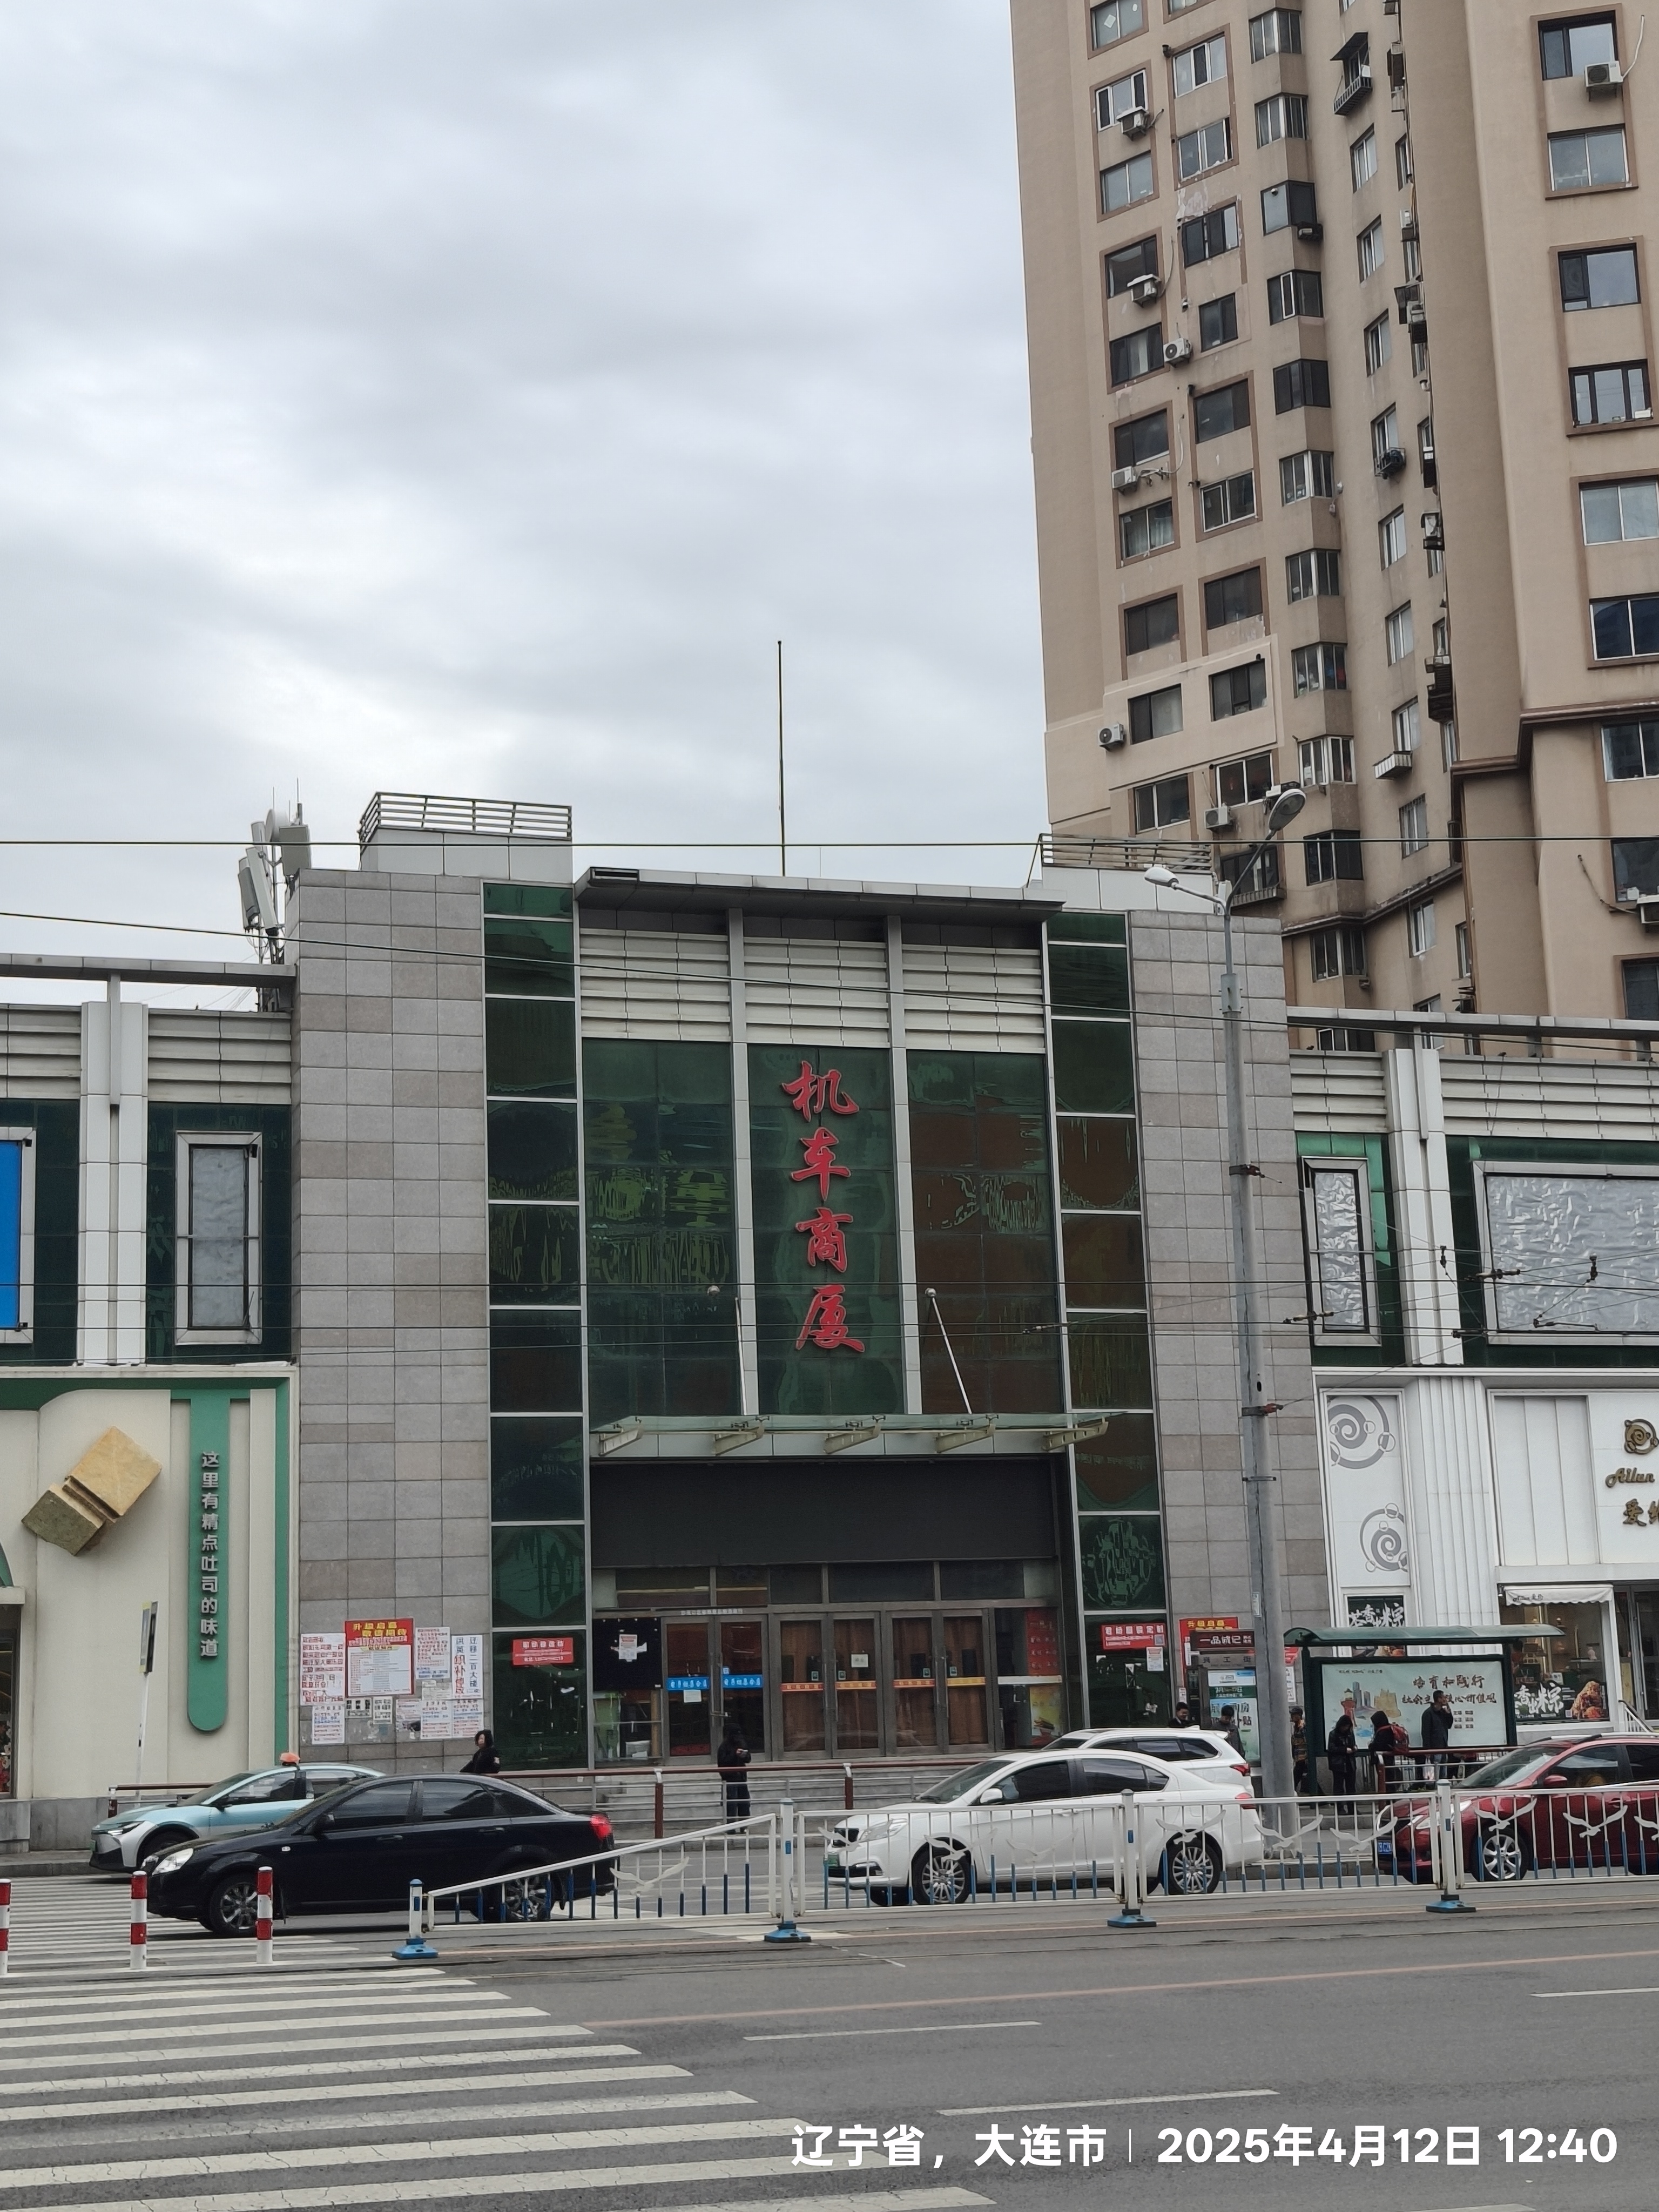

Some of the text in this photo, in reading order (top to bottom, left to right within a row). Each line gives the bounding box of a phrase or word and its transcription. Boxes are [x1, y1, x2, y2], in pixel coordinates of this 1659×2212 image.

[781, 1060, 865, 1352] 机车商厦
[200, 1451, 219, 1657] 这里有精点吐司的味道
[1605, 1467, 1655, 1488] Ailun
